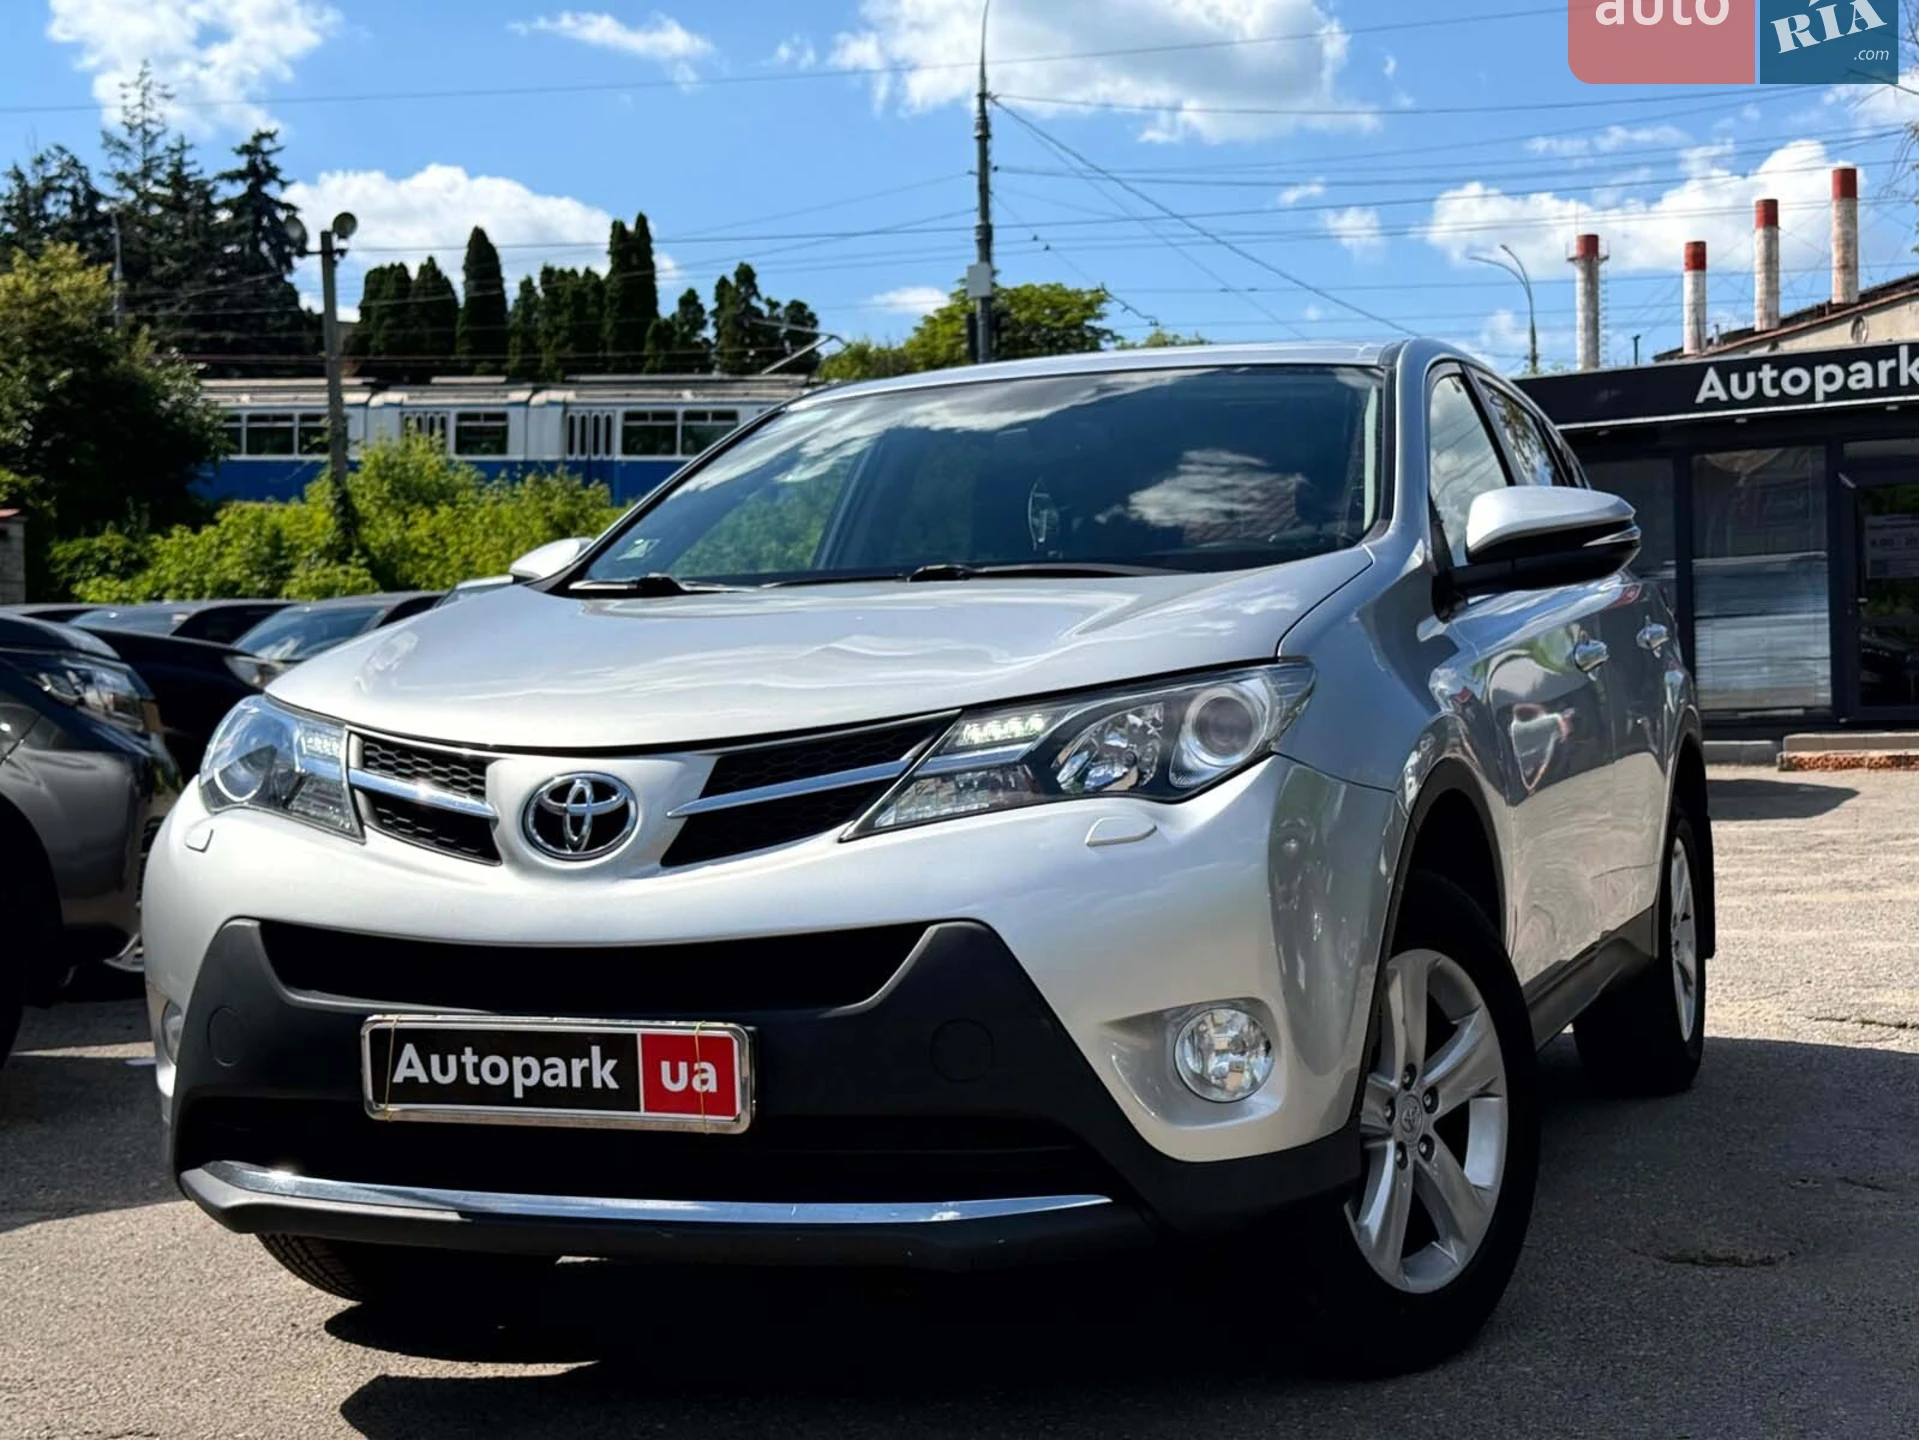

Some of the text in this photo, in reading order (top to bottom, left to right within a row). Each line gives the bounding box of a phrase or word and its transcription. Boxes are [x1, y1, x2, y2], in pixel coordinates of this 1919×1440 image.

[1695, 344, 1919, 403] Autopark
[392, 1043, 718, 1099] Autopark ua
